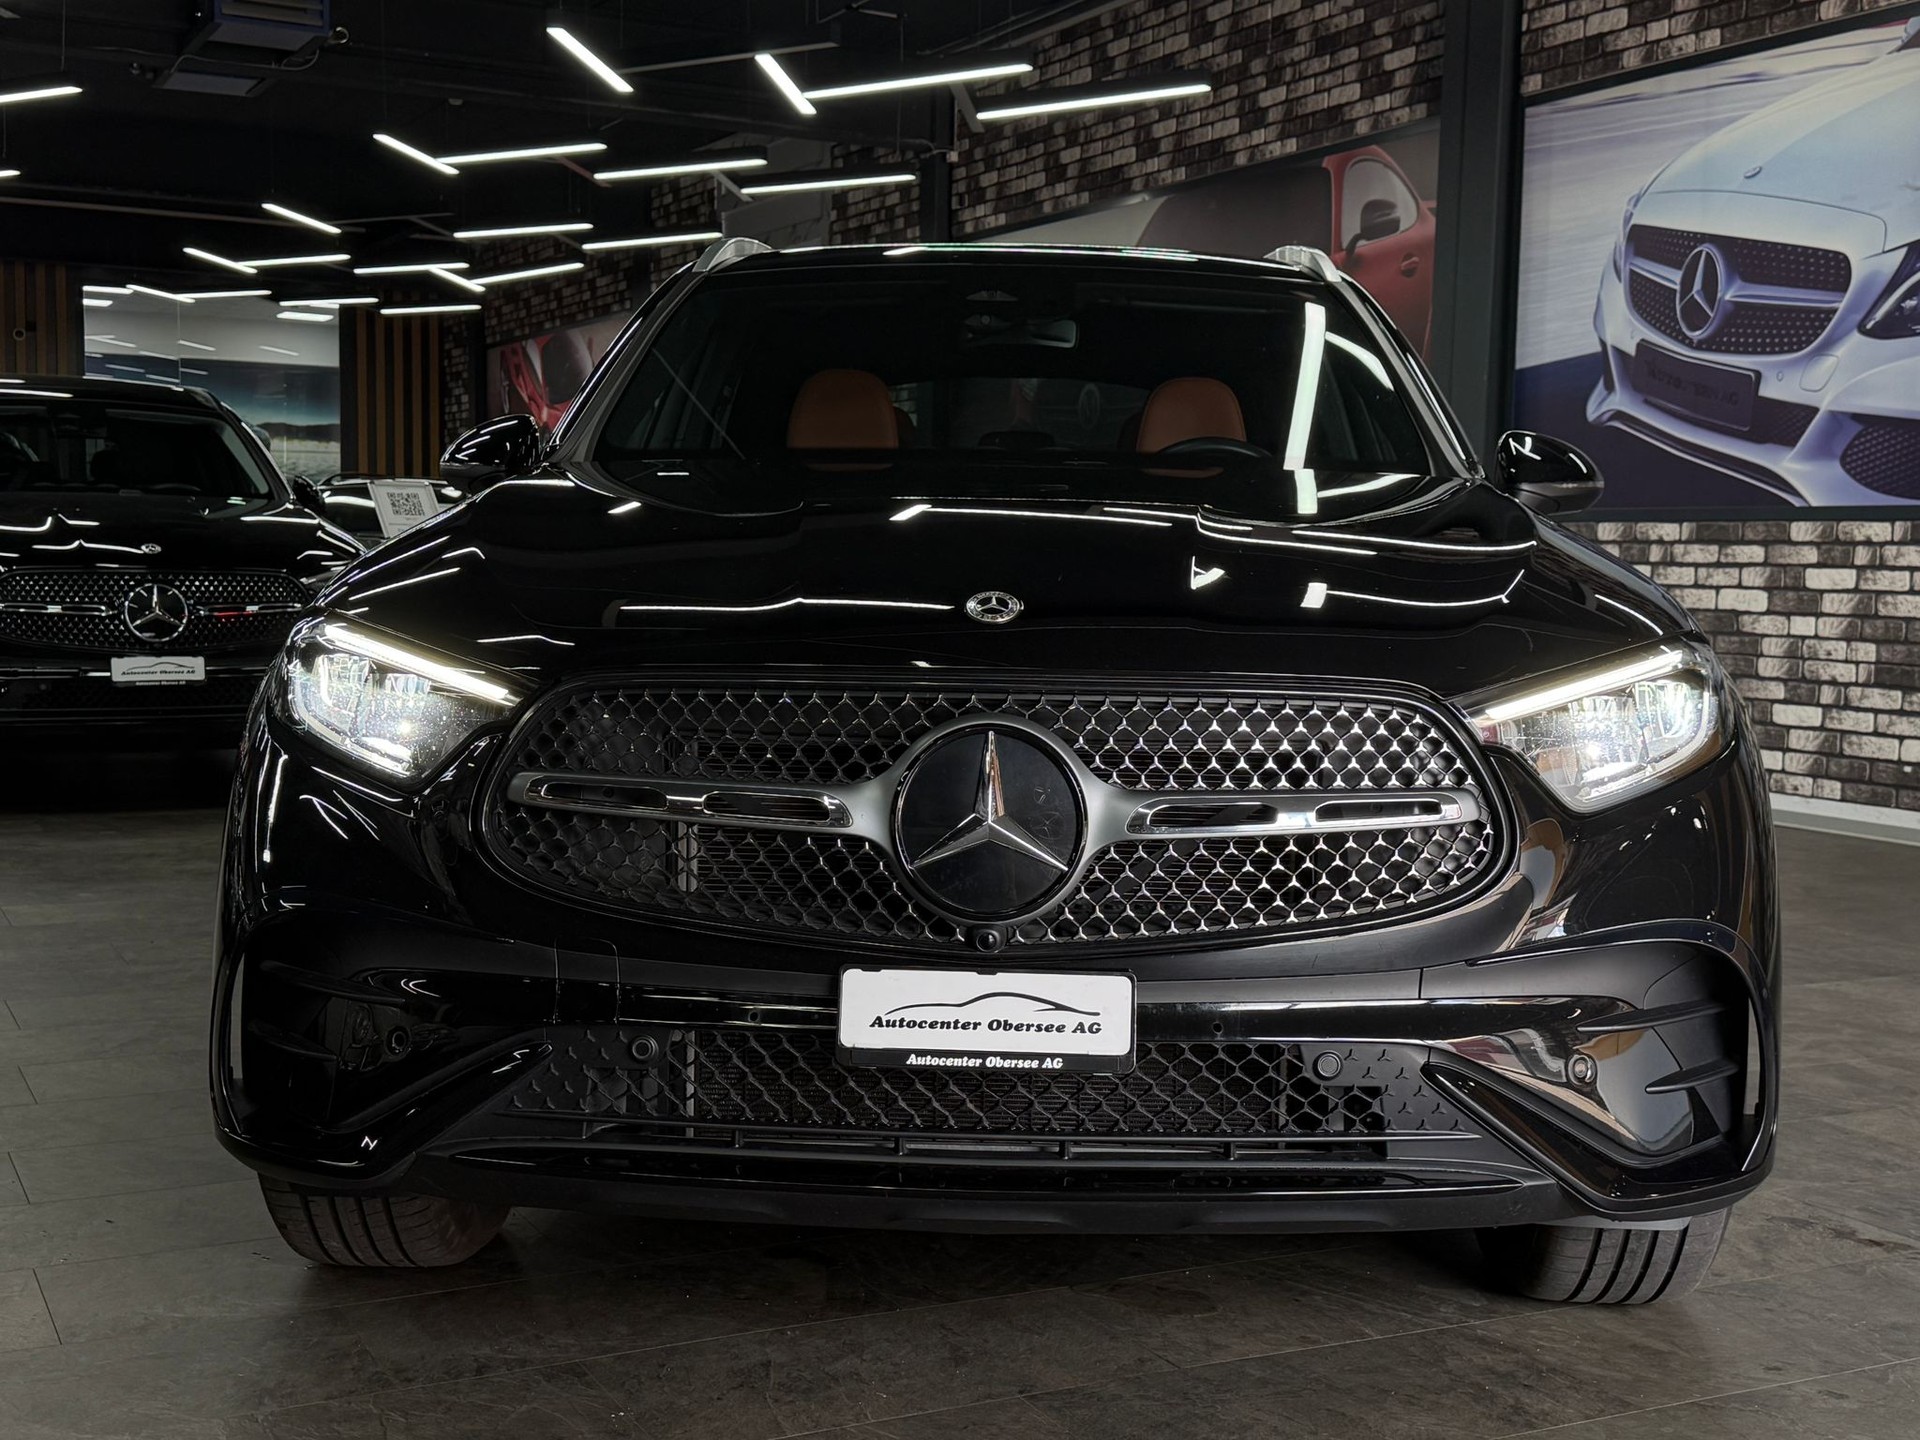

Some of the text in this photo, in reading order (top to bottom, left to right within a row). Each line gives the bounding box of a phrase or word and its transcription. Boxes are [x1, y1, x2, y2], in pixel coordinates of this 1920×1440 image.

[869, 1015, 1102, 1035] Autocenter Obersee AG
[906, 1053, 1064, 1070] Autocenter Obersee AG
